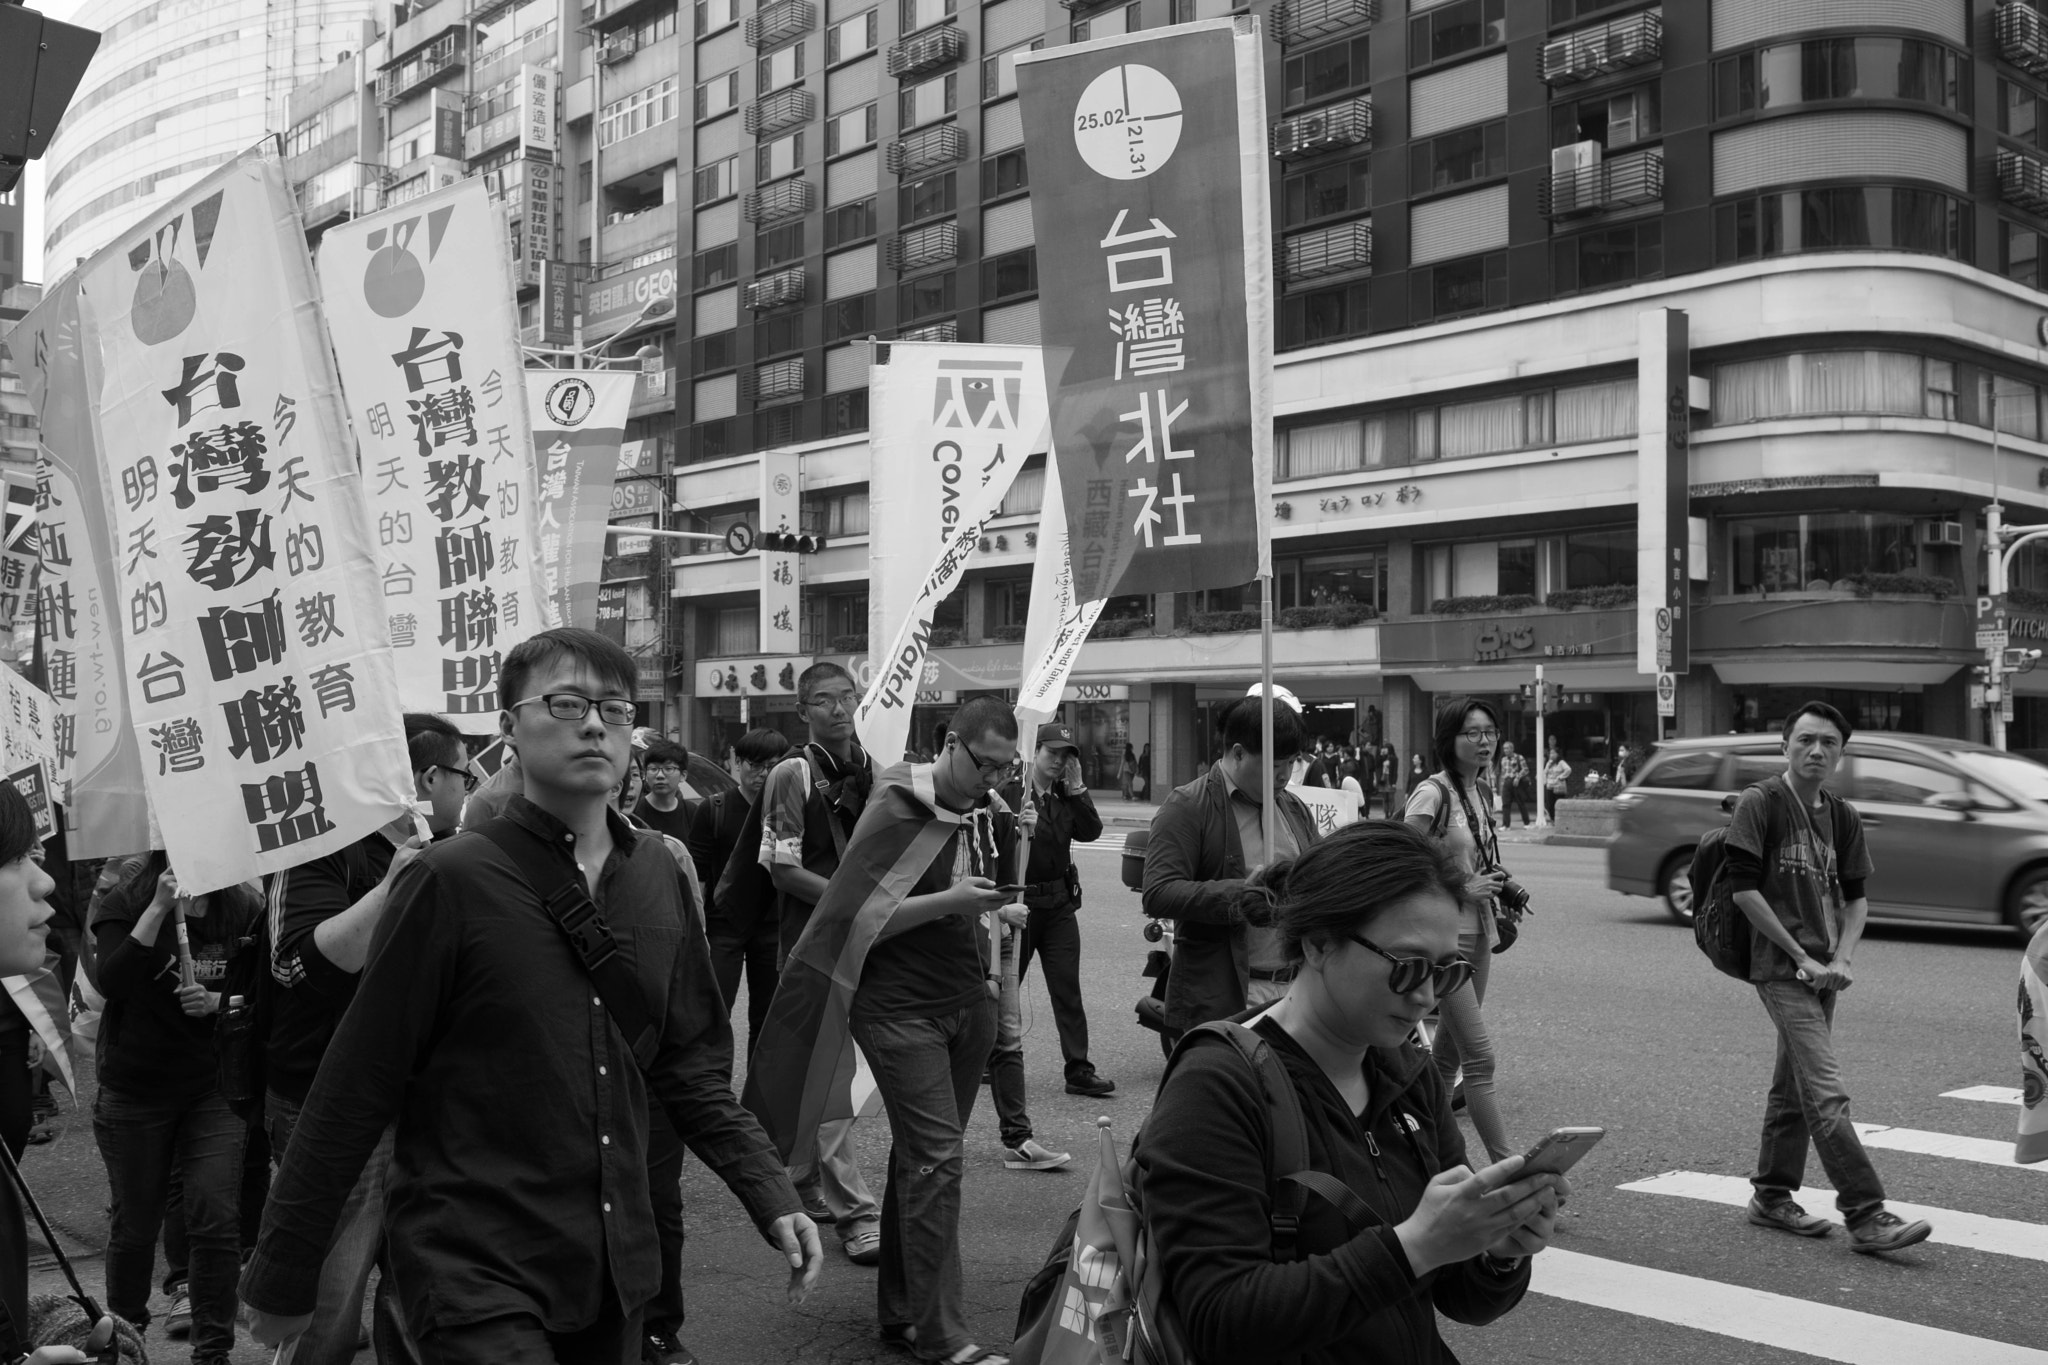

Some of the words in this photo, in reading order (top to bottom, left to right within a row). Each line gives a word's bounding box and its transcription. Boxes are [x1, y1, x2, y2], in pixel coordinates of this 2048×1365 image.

[1077, 108, 1125, 132] 25.02
[391, 326, 503, 715] 台灣教師聯盟
[479, 368, 520, 630] 今天的教育
[1100, 208, 1202, 550] 台灣北社
[121, 455, 206, 777] 明天的台灣
[161, 352, 339, 854] 台灣教師聯盟
[274, 392, 356, 720] 今天的教育
[880, 618, 934, 710] Watch
[1035, 668, 1065, 698] Taiwan
[1976, 597, 1993, 619] P
